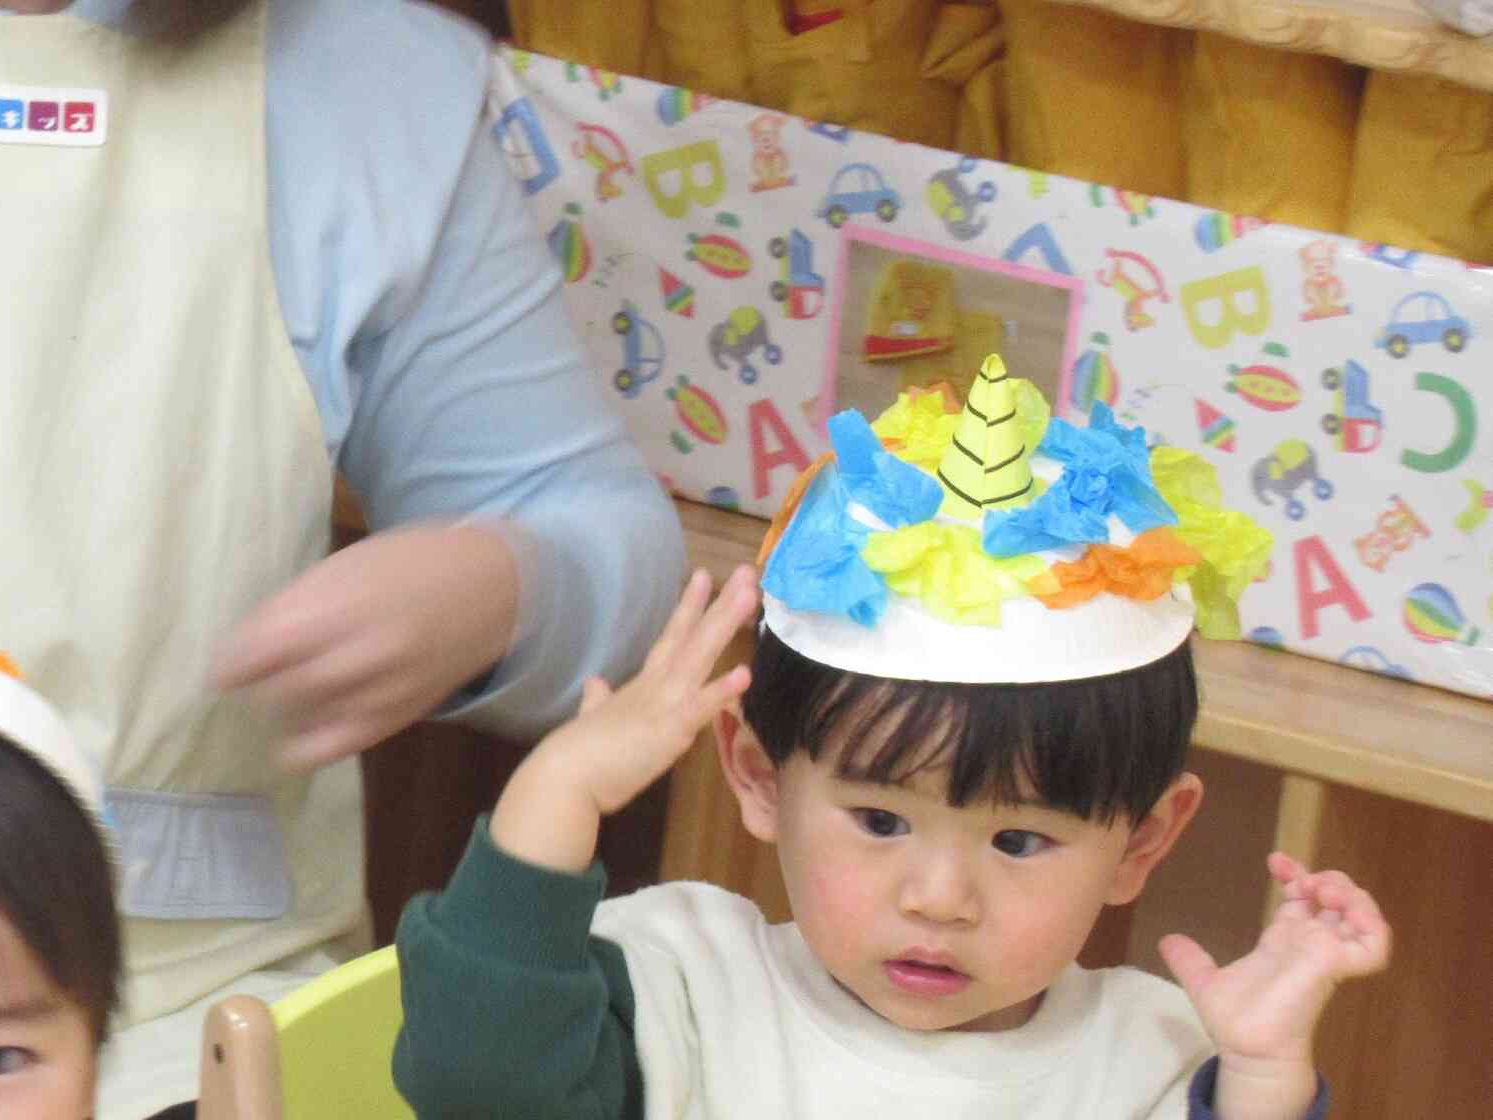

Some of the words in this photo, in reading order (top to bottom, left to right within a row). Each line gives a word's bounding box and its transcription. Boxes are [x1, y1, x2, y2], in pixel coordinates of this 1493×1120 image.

[640, 139, 726, 219] B
[1179, 264, 1272, 350] B
[747, 398, 813, 499] A
[1401, 371, 1478, 474] C
[1293, 535, 1374, 640] A
